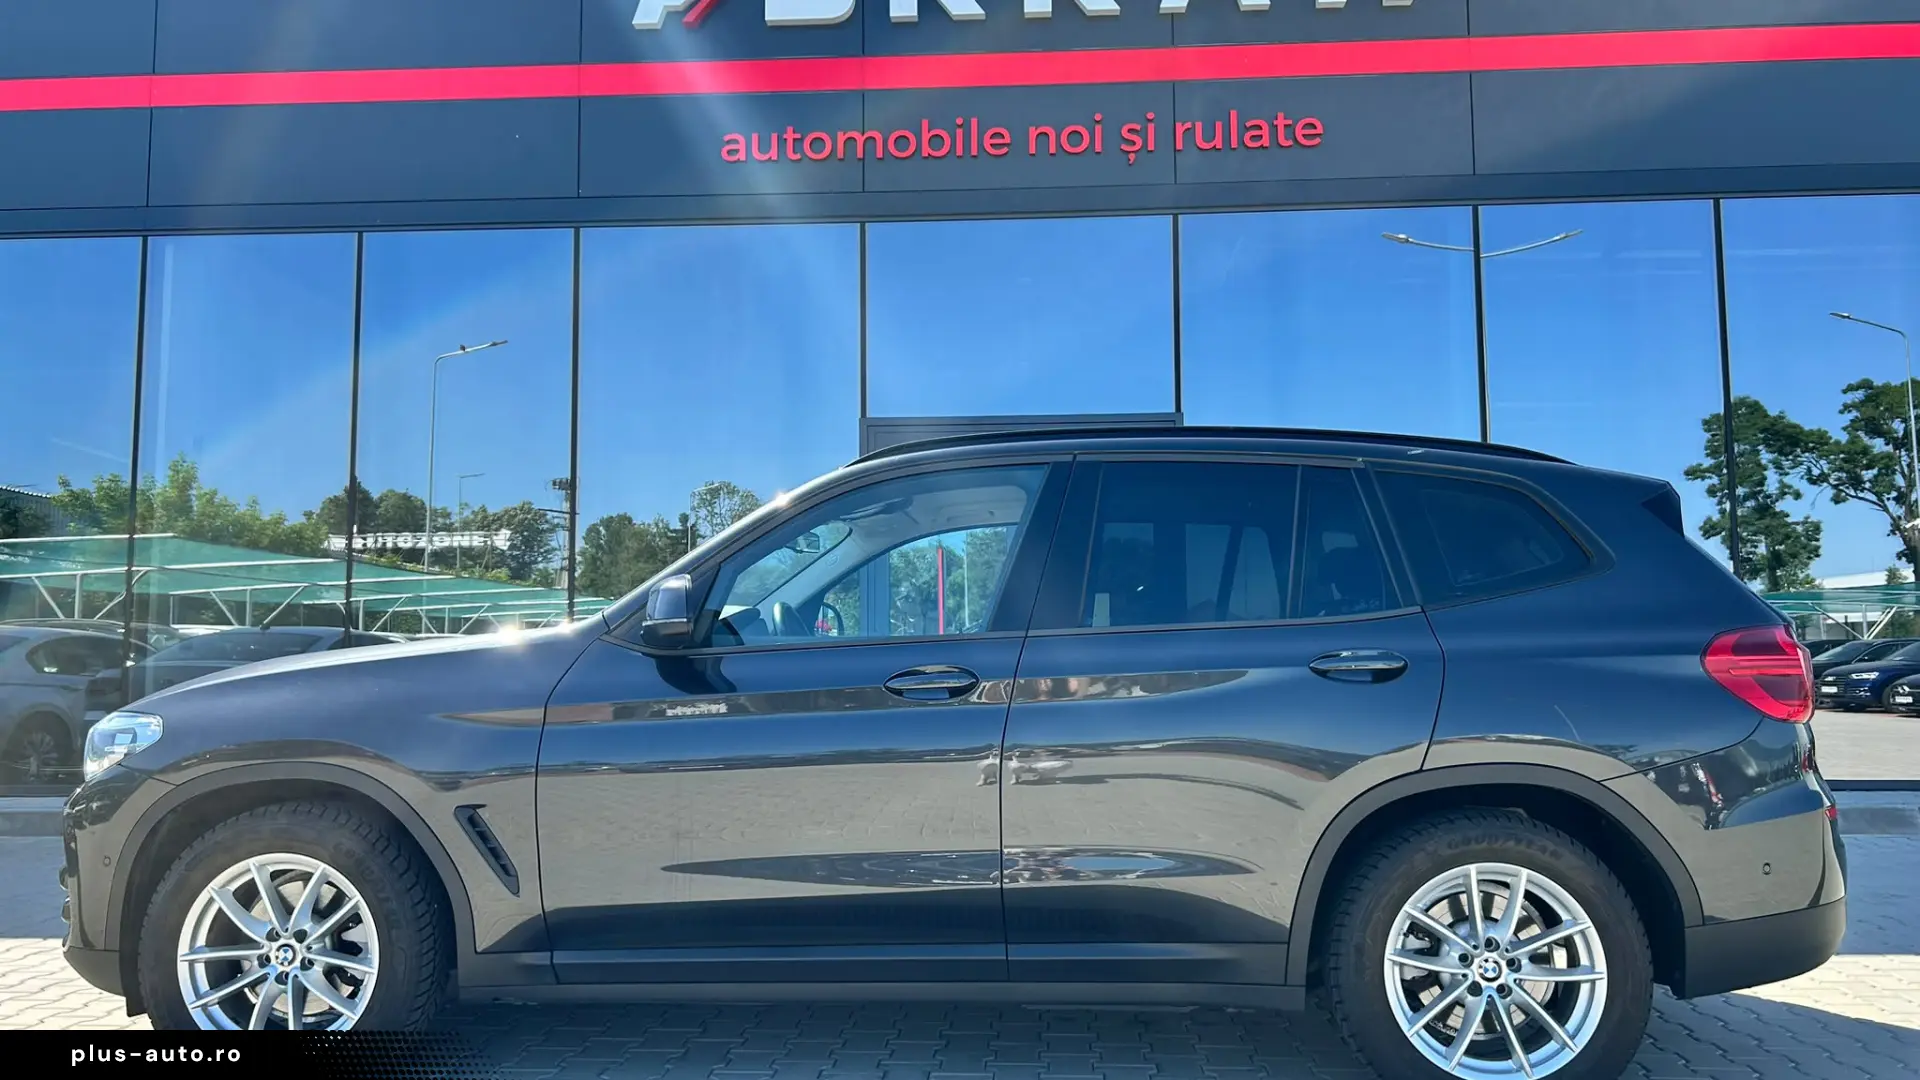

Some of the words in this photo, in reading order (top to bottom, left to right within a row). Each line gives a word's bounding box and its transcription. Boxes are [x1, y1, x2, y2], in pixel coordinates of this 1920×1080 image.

[720, 117, 1012, 161] automobile
[1028, 112, 1103, 155] noi
[1120, 111, 1155, 165] și
[1174, 109, 1324, 151] rulate
